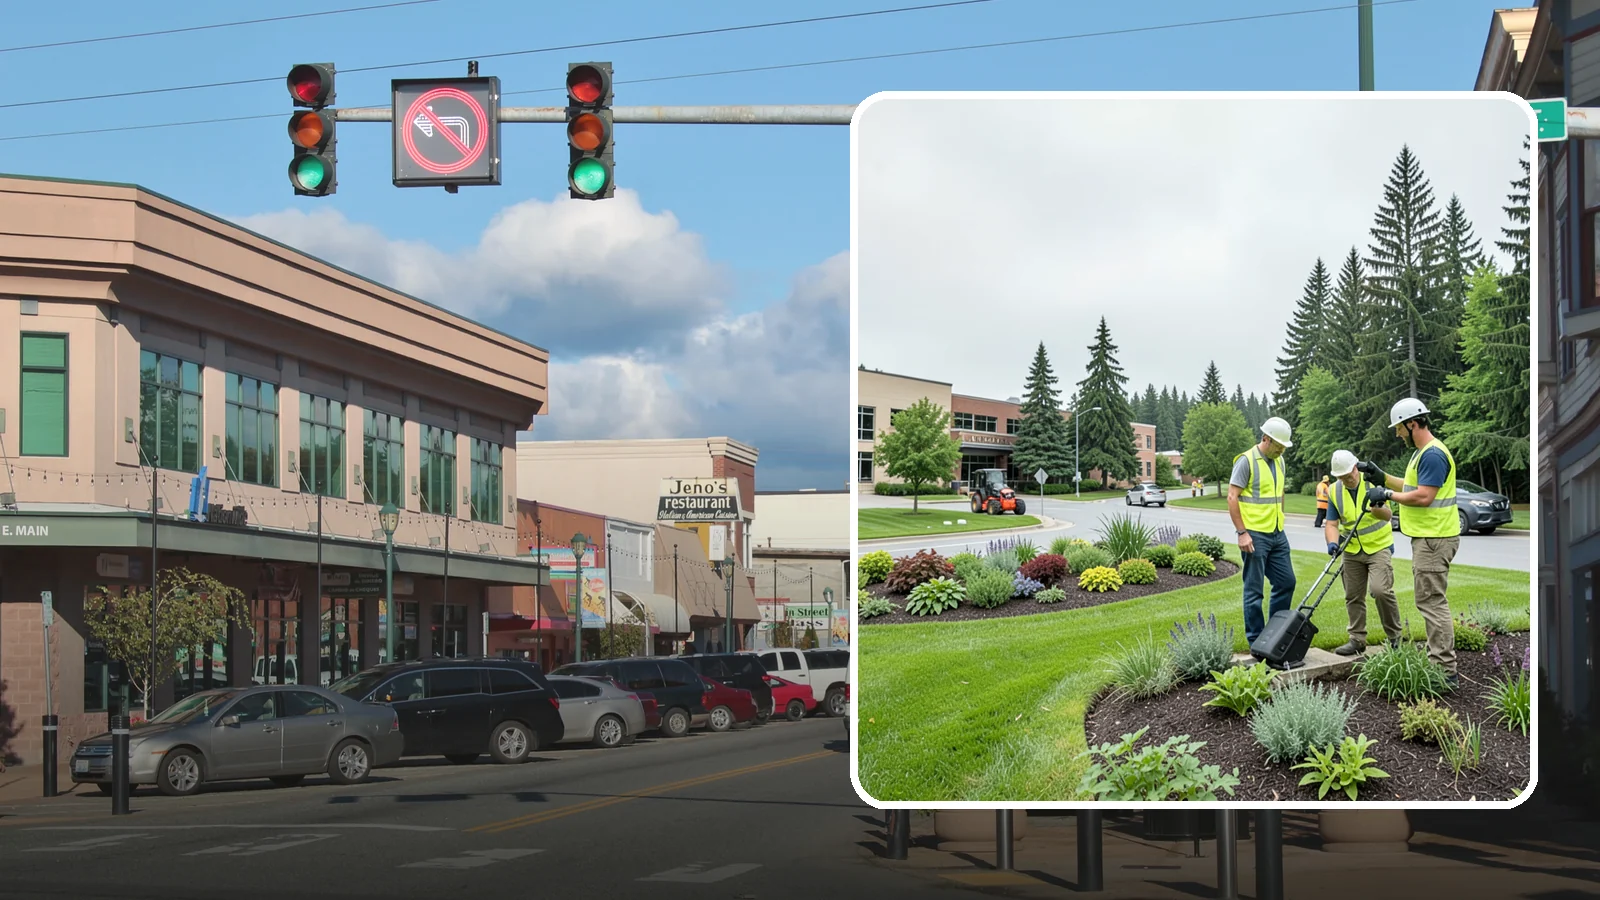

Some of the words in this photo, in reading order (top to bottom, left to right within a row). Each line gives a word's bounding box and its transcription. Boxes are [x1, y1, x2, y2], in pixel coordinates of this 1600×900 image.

[669, 480, 728, 495] Jeno's
[665, 496, 731, 509] restaurant
[659, 510, 682, 519] Italian
[686, 509, 715, 519] American
[715, 509, 738, 519] Cuisine
[2, 525, 13, 536] E.
[15, 525, 49, 536] MAIN
[797, 607, 829, 617] Street
